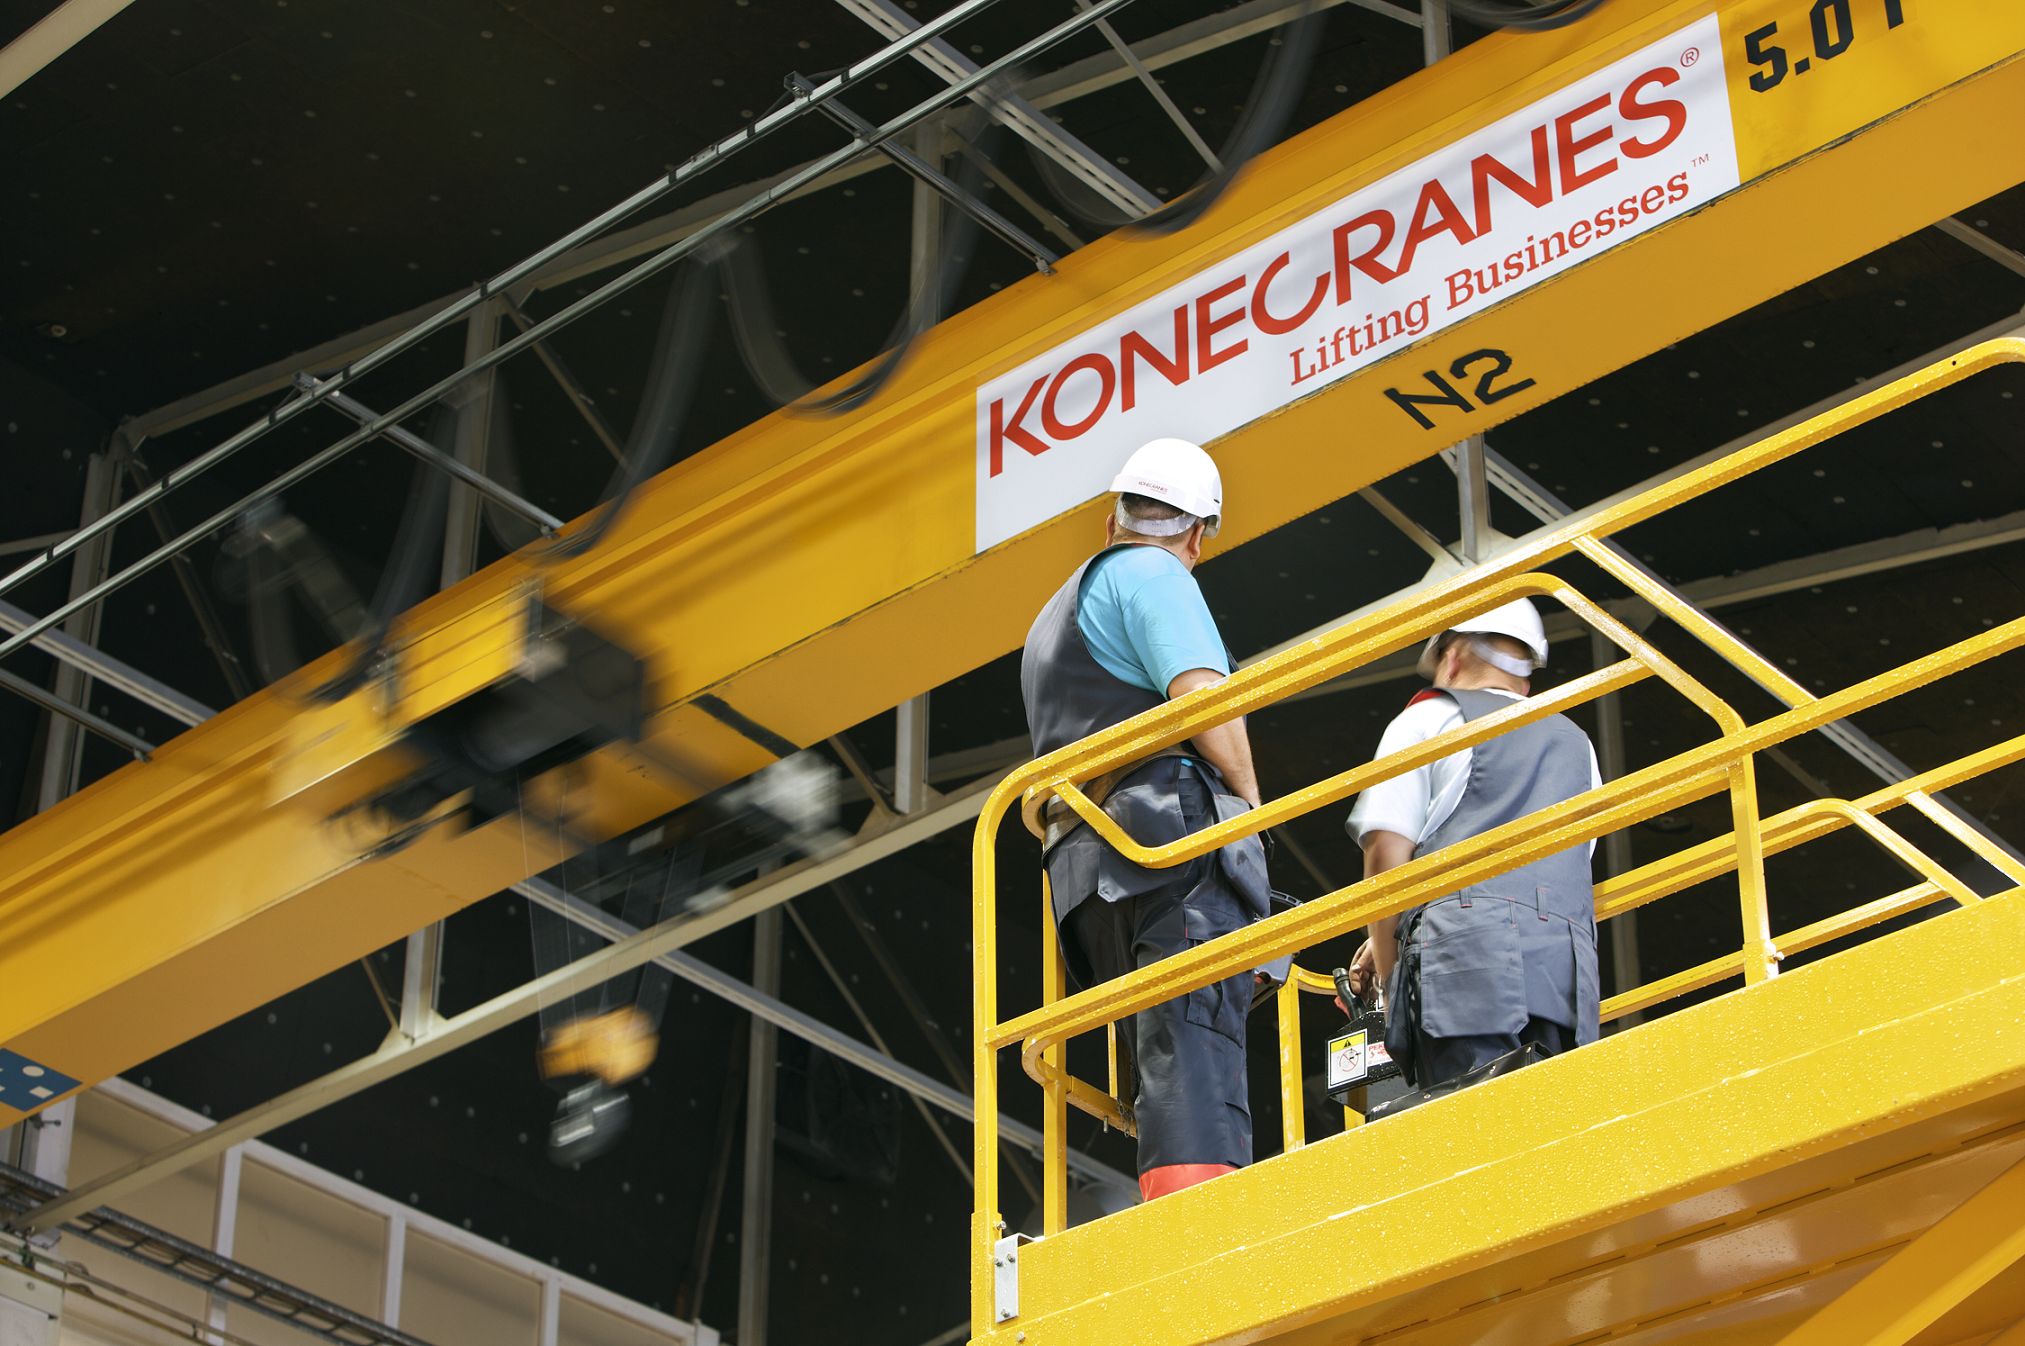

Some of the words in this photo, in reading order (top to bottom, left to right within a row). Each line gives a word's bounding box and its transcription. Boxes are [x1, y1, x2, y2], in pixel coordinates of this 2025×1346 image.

[1744, 0, 1854, 93] 5.0
[1289, 295, 1430, 386] Lifting
[1444, 171, 1689, 311] Businesses
[1383, 348, 1537, 430] N2
